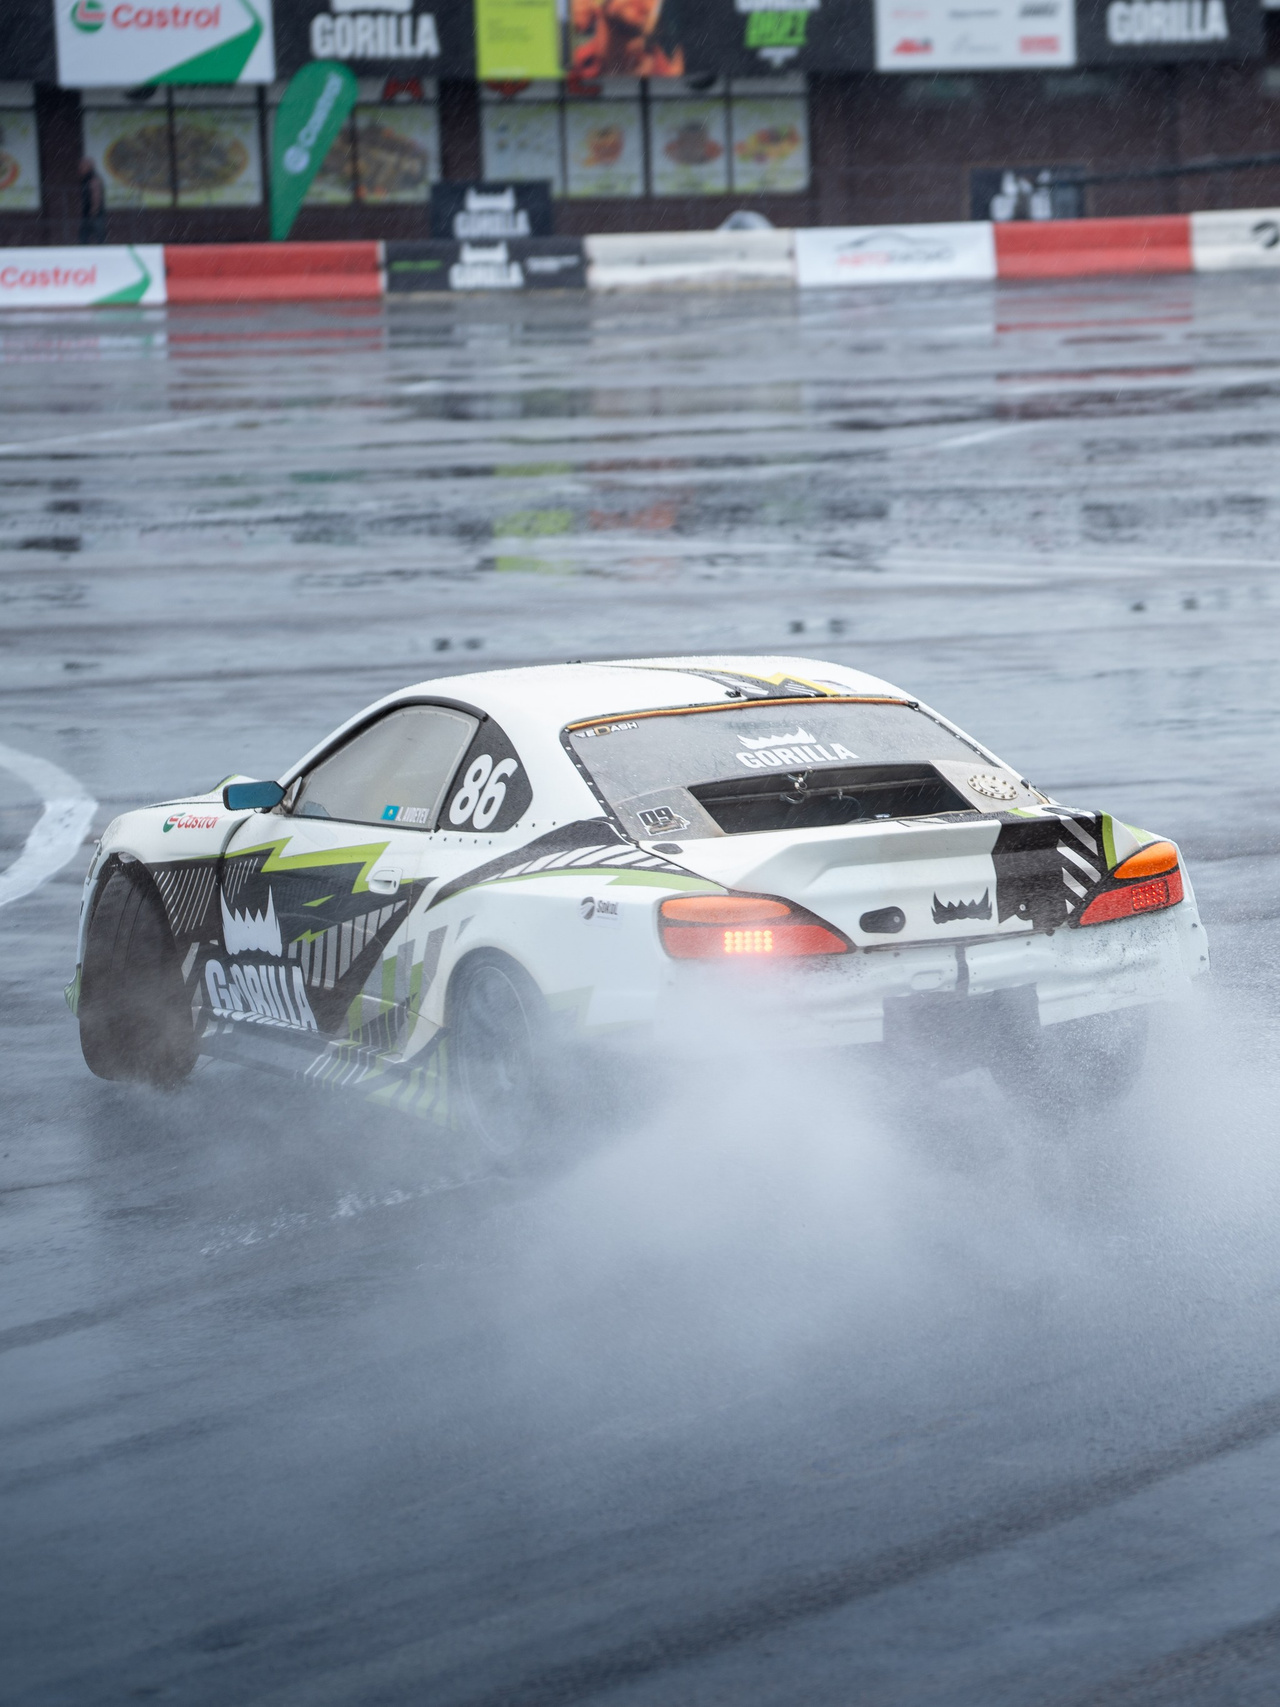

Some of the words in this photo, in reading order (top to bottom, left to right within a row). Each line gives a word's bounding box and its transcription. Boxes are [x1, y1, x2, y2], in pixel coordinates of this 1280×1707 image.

[111, 3, 222, 29] Castrol
[1107, 0, 1230, 45] GORILLA
[310, 12, 440, 59] GORILLA
[0, 264, 97, 289] Castrol
[735, 742, 860, 769] GORILLA
[449, 753, 519, 830] 86
[177, 814, 219, 829] Castrol
[204, 958, 319, 1034] GORILLA
